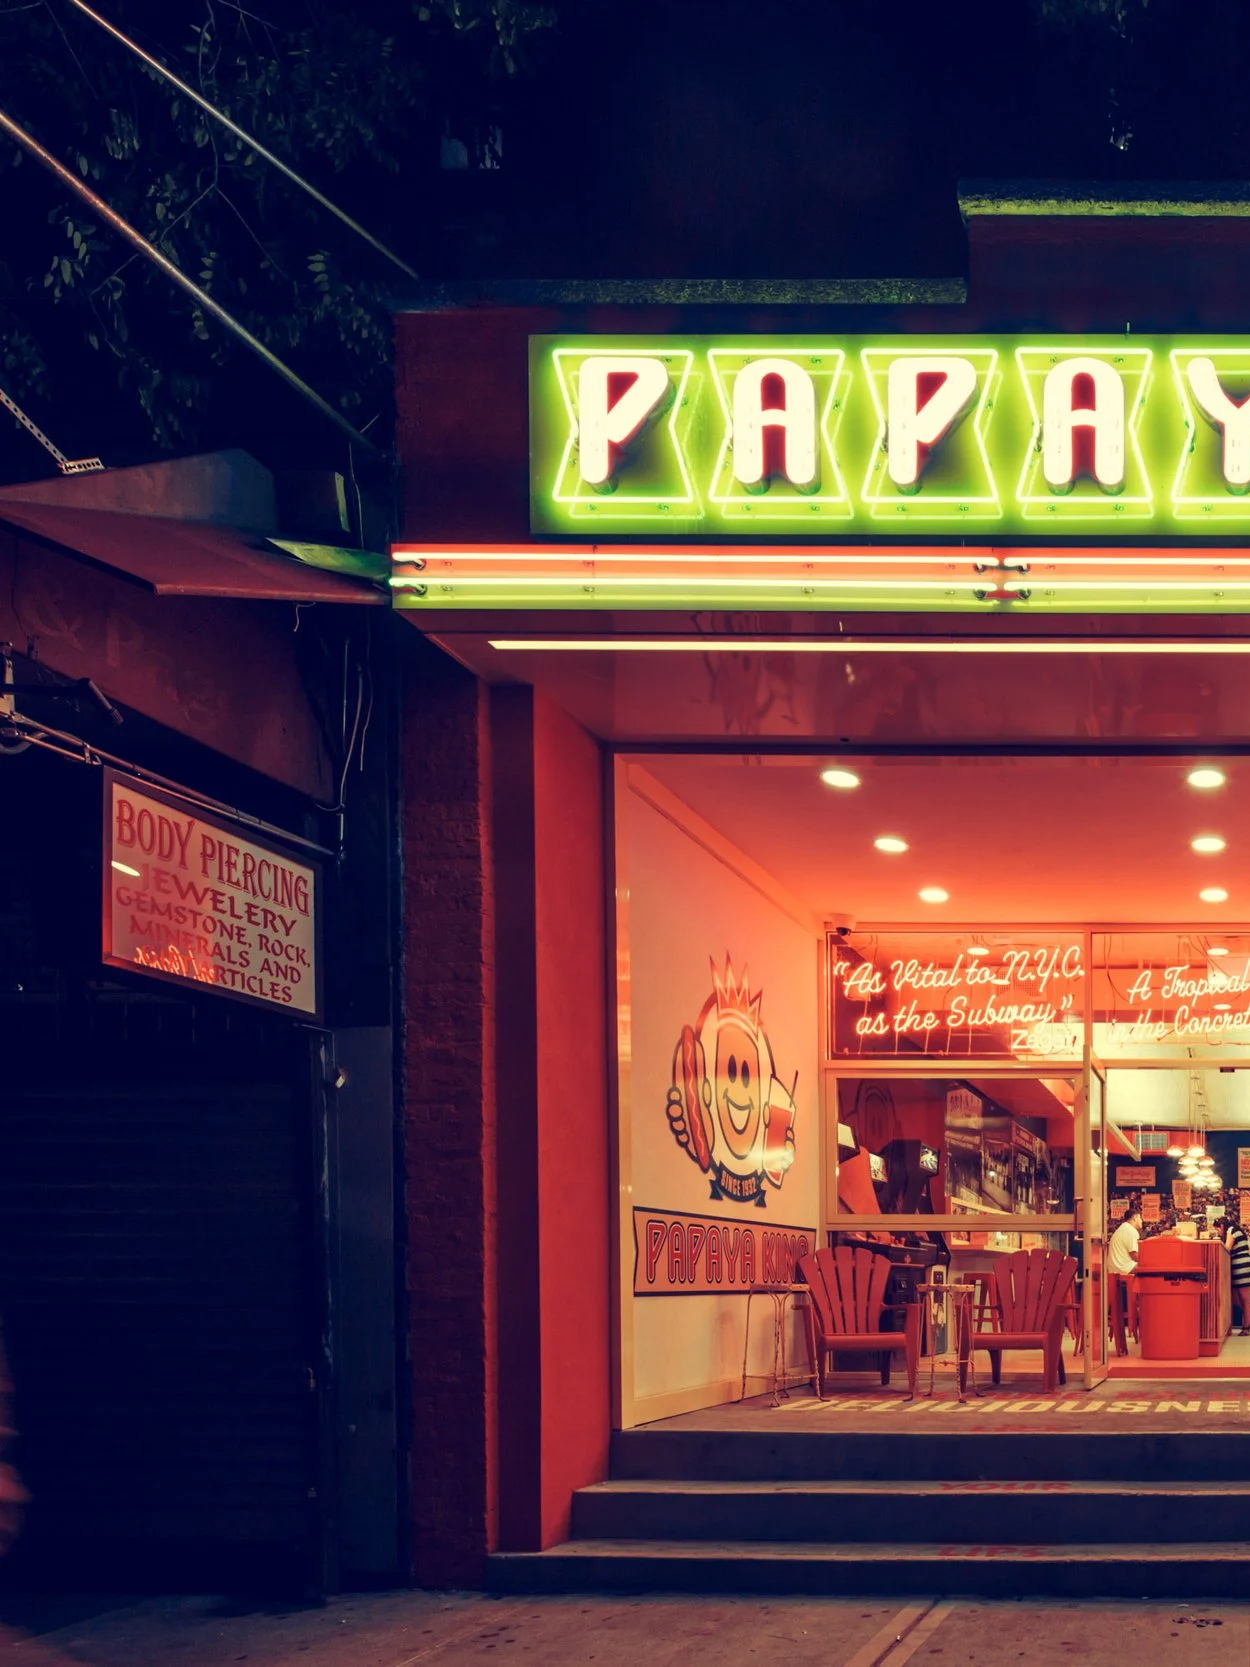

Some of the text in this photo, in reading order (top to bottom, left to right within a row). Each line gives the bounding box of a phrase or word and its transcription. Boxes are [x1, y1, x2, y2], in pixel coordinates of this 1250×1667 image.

[116, 798, 310, 917] BODY PIERCING
[140, 863, 297, 937] JEWELERY
[129, 914, 250, 968] MINERALS
[260, 957, 302, 985] AND
[890, 953, 963, 991] Vital
[965, 959, 998, 985] to
[1002, 946, 1086, 993] N.Y.C.
[1126, 970, 1152, 1005] A
[1161, 958, 1250, 1007] Tropical
[856, 1012, 889, 1036] as
[893, 999, 940, 1033] the
[1130, 1008, 1168, 1042] the
[720, 1170, 741, 1197] SINCE
[646, 1219, 756, 1284] PAPAYA
[939, 1482, 1072, 1491] YOUR
[938, 1546, 1047, 1557] LIPS
